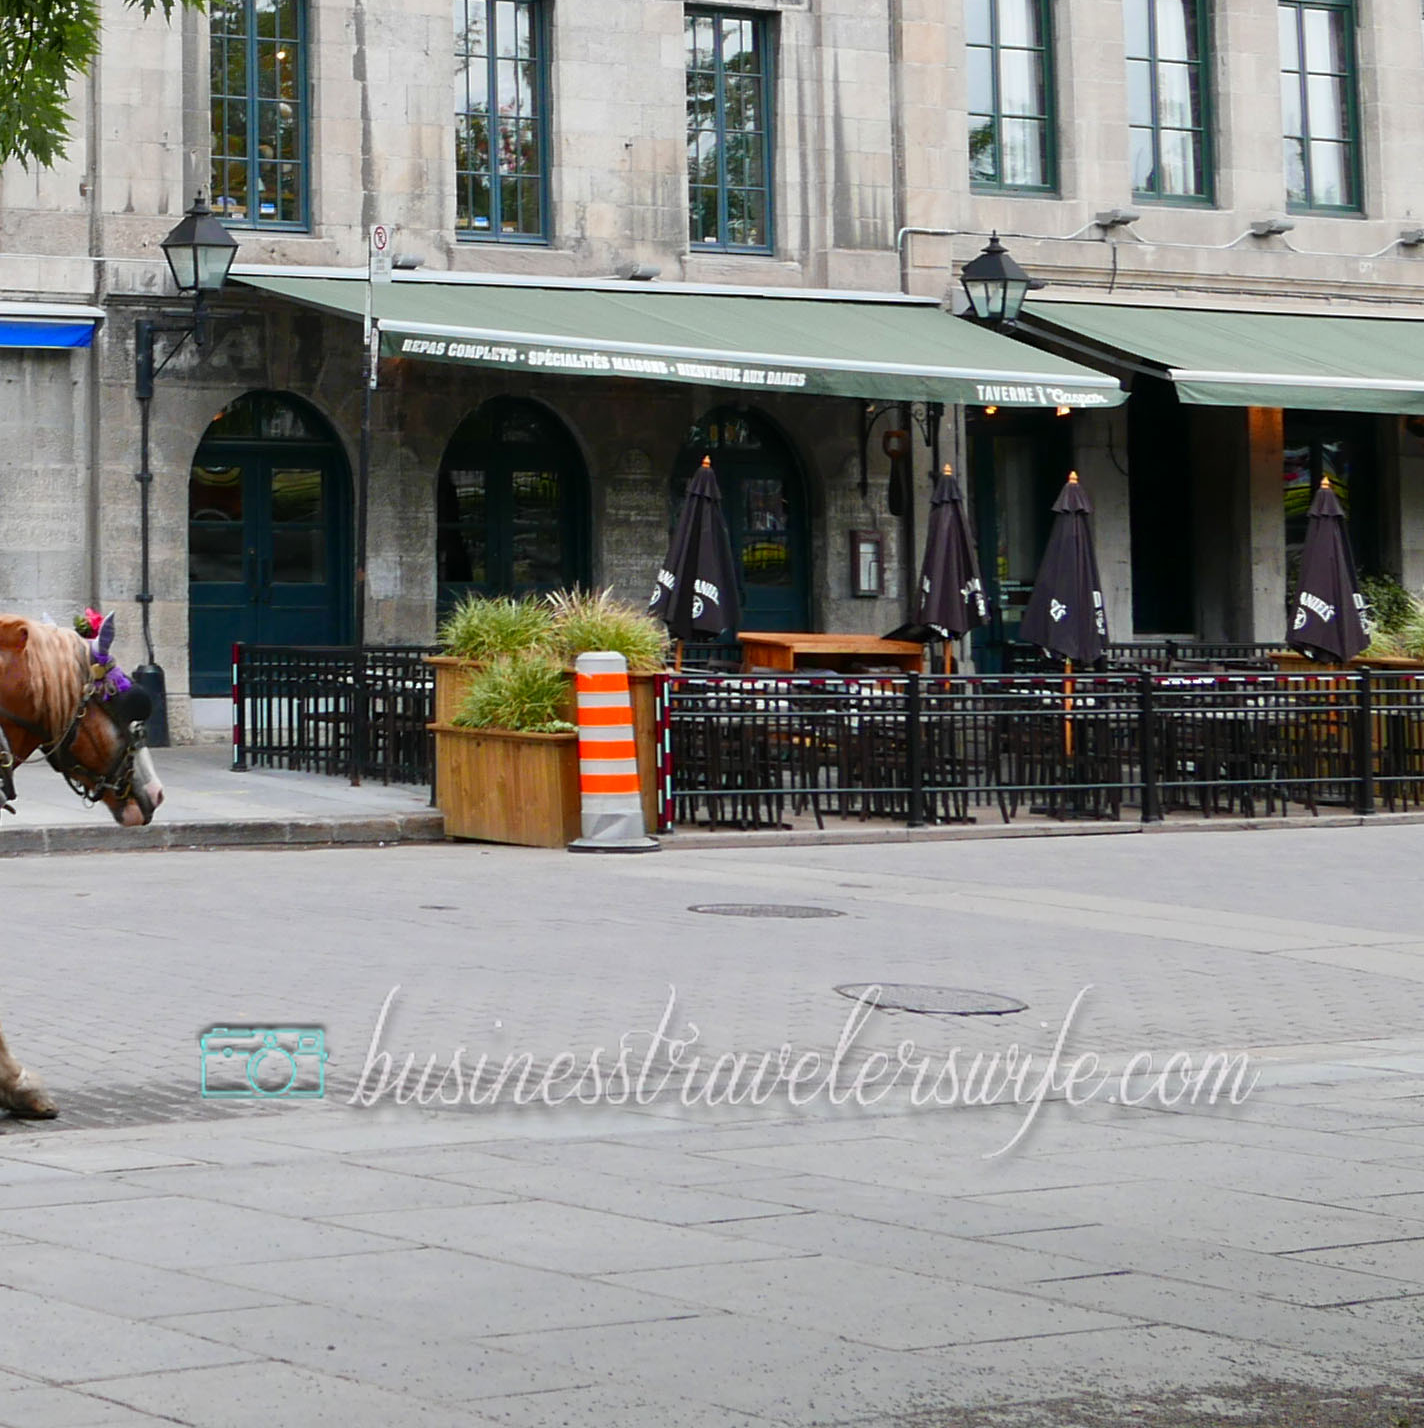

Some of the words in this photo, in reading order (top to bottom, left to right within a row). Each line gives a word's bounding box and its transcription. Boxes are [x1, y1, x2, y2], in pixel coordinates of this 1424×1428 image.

[402, 338, 446, 356] REPAS
[447, 343, 518, 363] COMPLETS
[527, 348, 611, 370] SPÉCIALITÉS
[611, 356, 669, 375] MAISONS
[675, 362, 742, 383] BIENVENUE
[742, 369, 766, 385] AUX
[766, 371, 807, 387] DAMES
[975, 384, 1036, 403] TAVERNE
[1046, 387, 1109, 408] Gaspar
